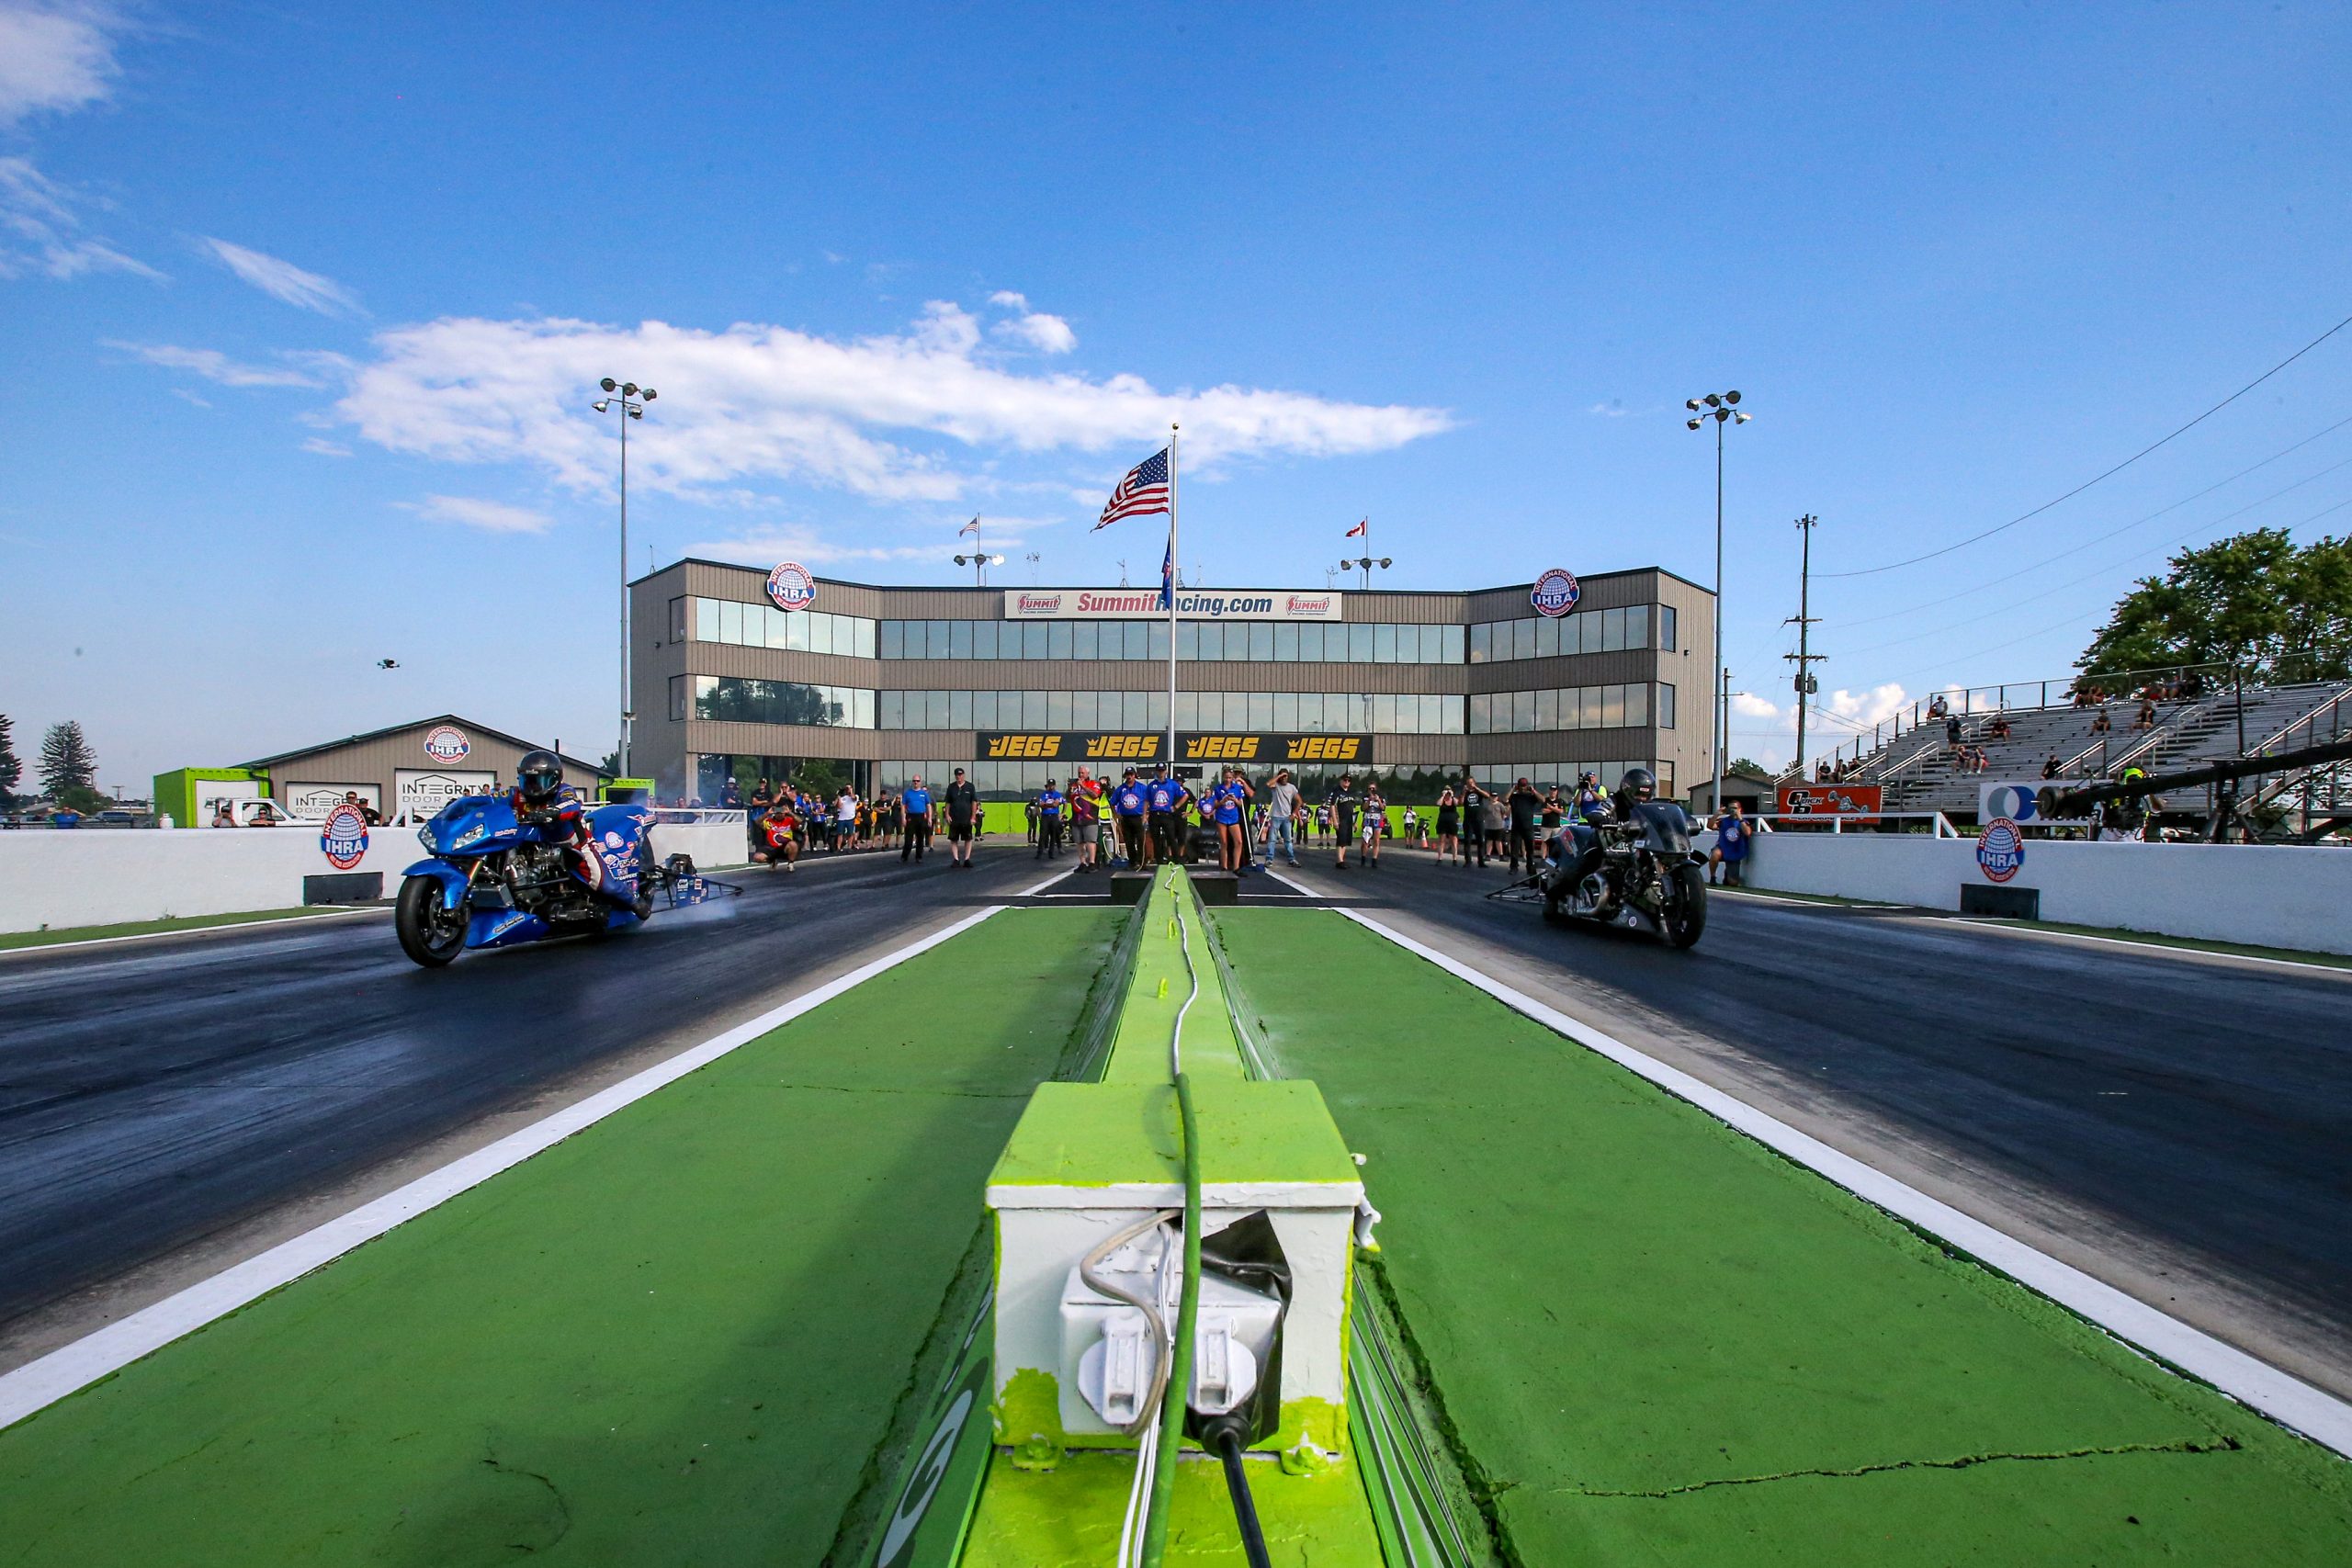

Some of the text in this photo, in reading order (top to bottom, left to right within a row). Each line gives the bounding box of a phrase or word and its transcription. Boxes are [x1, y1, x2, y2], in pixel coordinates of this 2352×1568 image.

[772, 563, 811, 586] INTERNATIONAL
[1535, 570, 1575, 593] INTERNATIONAL
[774, 585, 809, 599] IHRA
[1537, 592, 1573, 605] IHRA
[430, 745, 465, 754] IHRA
[989, 736, 1061, 757] JEGS
[1086, 736, 1159, 758] JEGS
[1186, 737, 1260, 759] JEGS
[1287, 738, 1360, 760] JEGS
[324, 807, 367, 836] INTERNATIONAL
[1979, 819, 2020, 849] INTERNATIONAL
[325, 838, 365, 854] IHRA
[1981, 851, 2018, 867] IHRA
